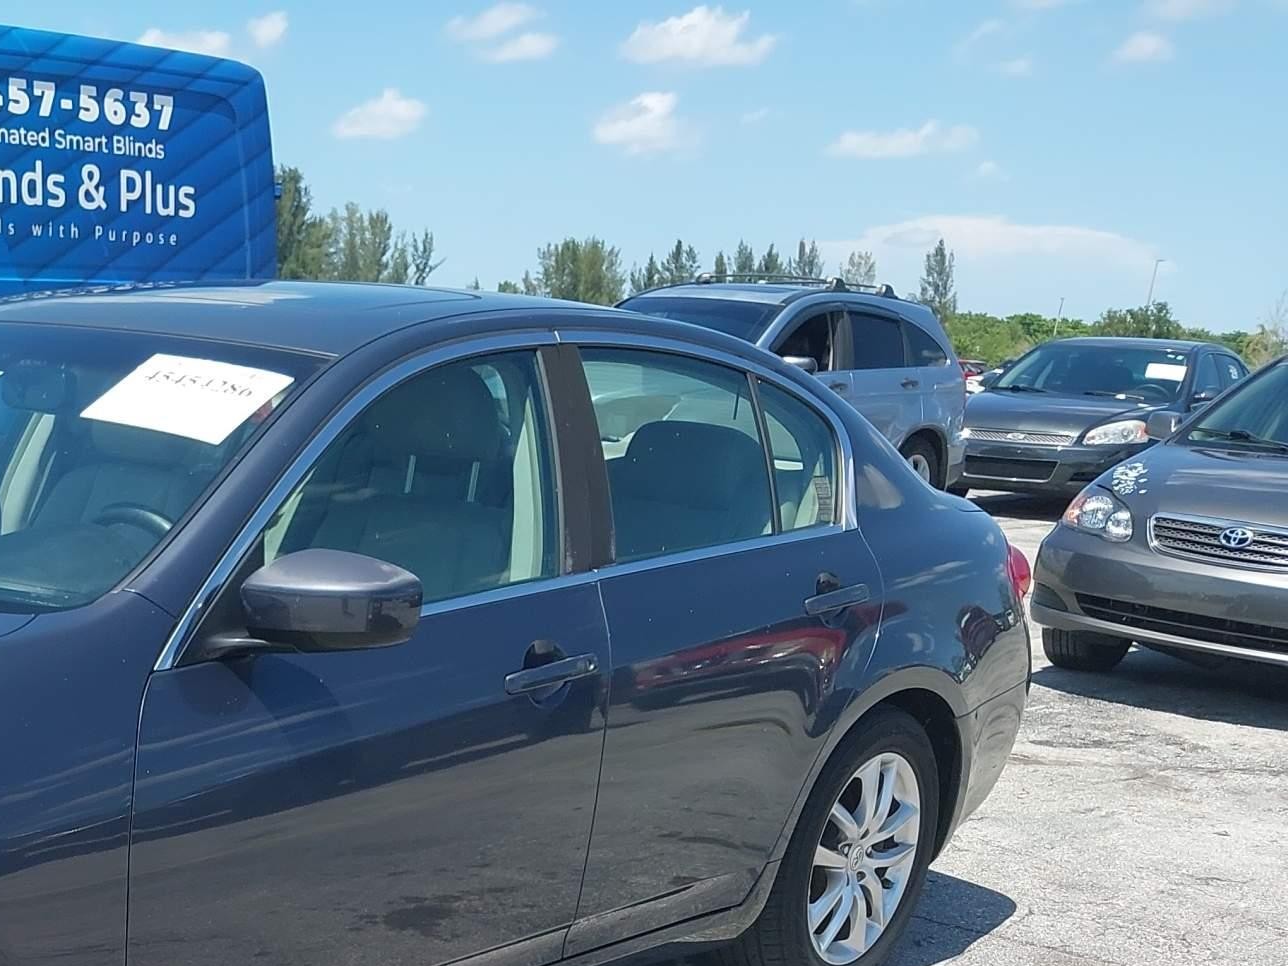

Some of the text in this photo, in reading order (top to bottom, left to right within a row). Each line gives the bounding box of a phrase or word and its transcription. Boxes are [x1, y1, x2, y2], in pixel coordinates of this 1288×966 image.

[54, 129, 109, 153] Smart
[113, 136, 165, 159] Blinds
[78, 163, 107, 211] &
[120, 169, 196, 218] Plus
[31, 220, 80, 239] with
[95, 225, 178, 247] Purpose
